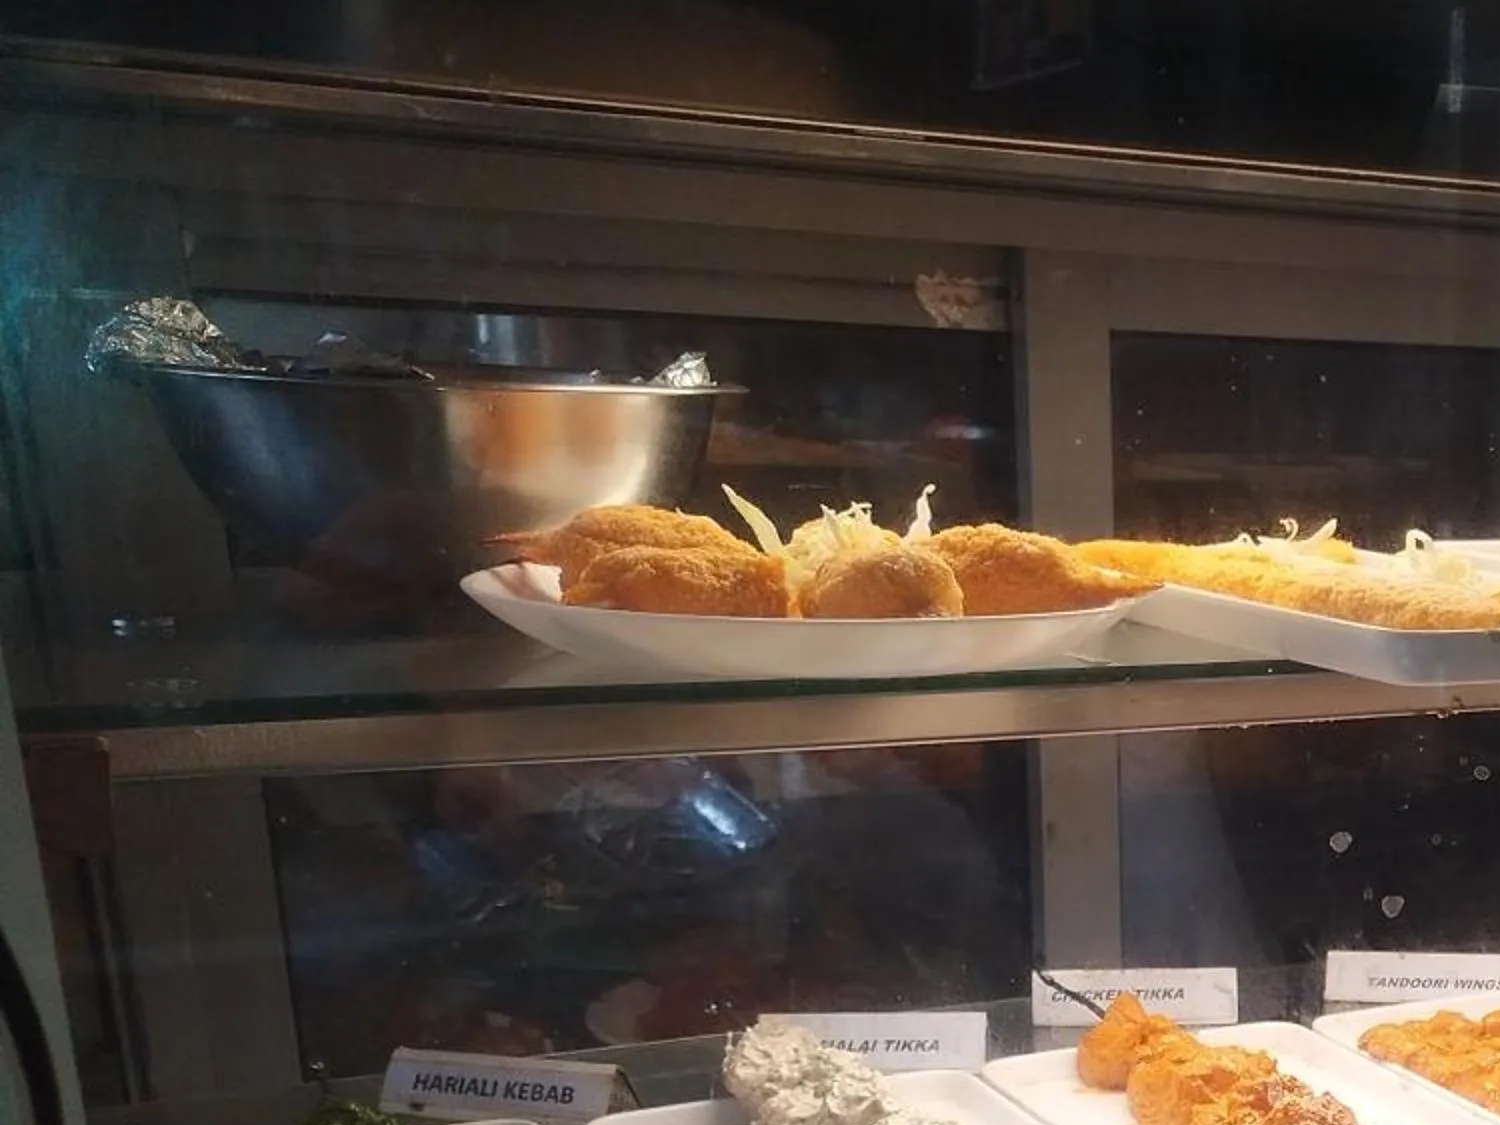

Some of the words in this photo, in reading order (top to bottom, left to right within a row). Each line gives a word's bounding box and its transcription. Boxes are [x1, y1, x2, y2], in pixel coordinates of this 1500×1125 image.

[1367, 976, 1450, 990] TANDOORI
[1051, 986, 1128, 1003] CCKE
[883, 1038, 940, 1053] TIKKA
[412, 1072, 499, 1098] HARIALI
[502, 1080, 576, 1105] KEBAB
